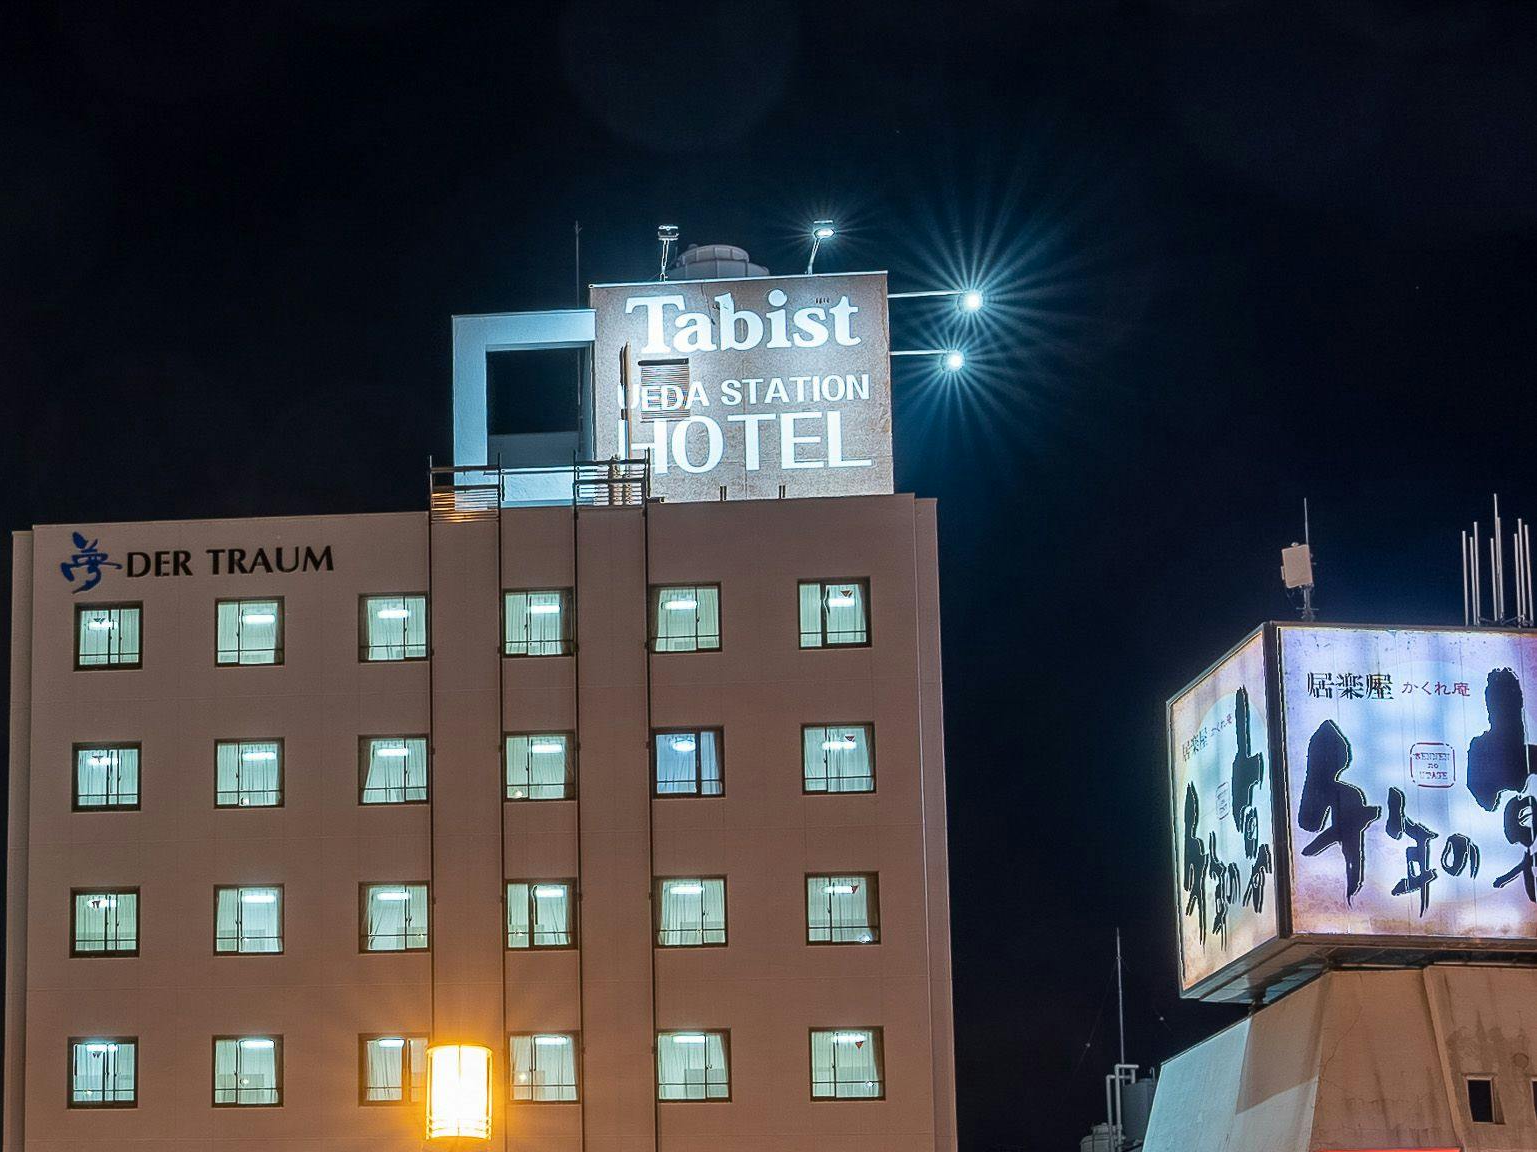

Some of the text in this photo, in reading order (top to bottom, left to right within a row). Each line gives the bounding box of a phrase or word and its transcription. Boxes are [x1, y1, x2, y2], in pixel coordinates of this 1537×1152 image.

[625, 288, 863, 355] Tabist
[618, 373, 871, 411] UEDA STATION
[618, 410, 873, 476] HOTEL
[126, 545, 335, 578] DER TRAUM
[1307, 671, 1472, 700] 居楽屋 かくれ庵
